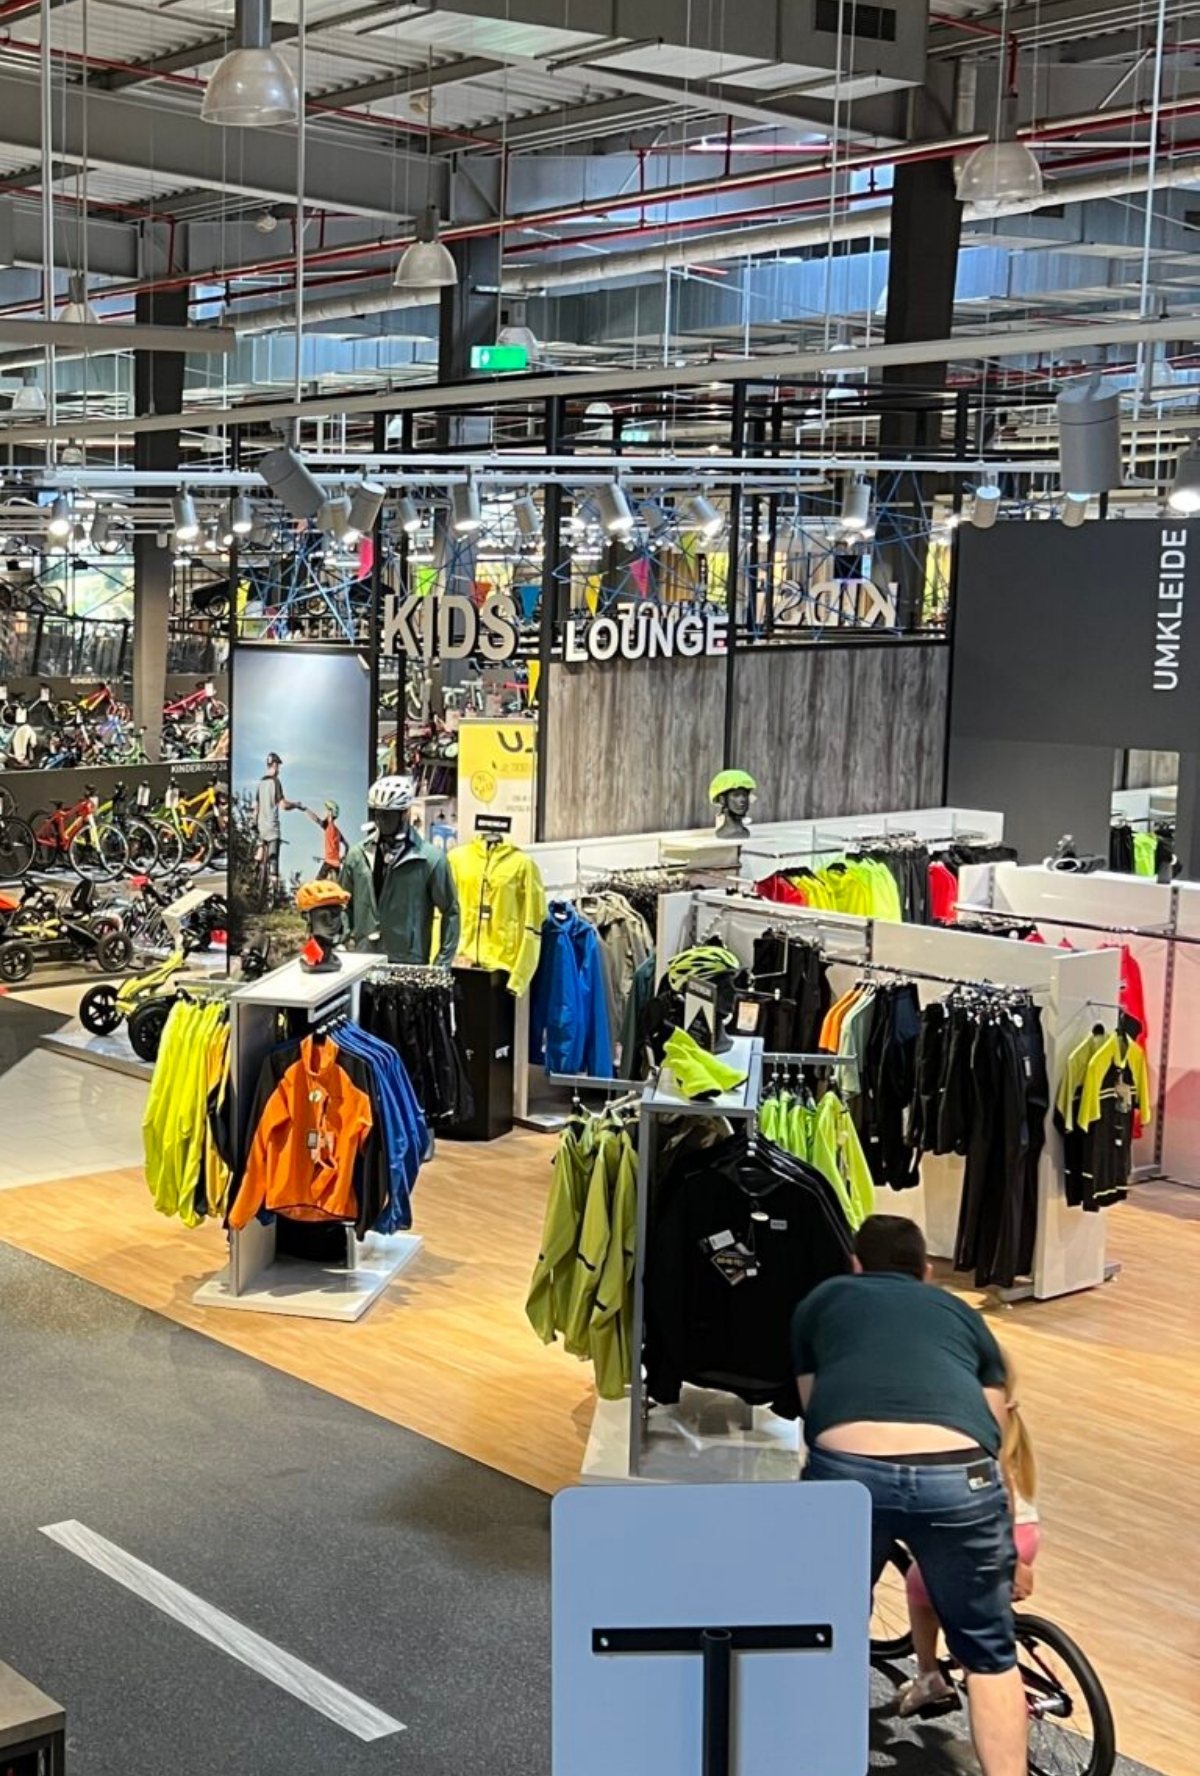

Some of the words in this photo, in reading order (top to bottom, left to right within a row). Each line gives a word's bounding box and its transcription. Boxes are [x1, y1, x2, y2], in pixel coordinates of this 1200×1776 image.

[382, 594, 518, 662] KIDS
[564, 615, 730, 663] LOUNGE
[1153, 529, 1187, 691] UMKLEIDE
